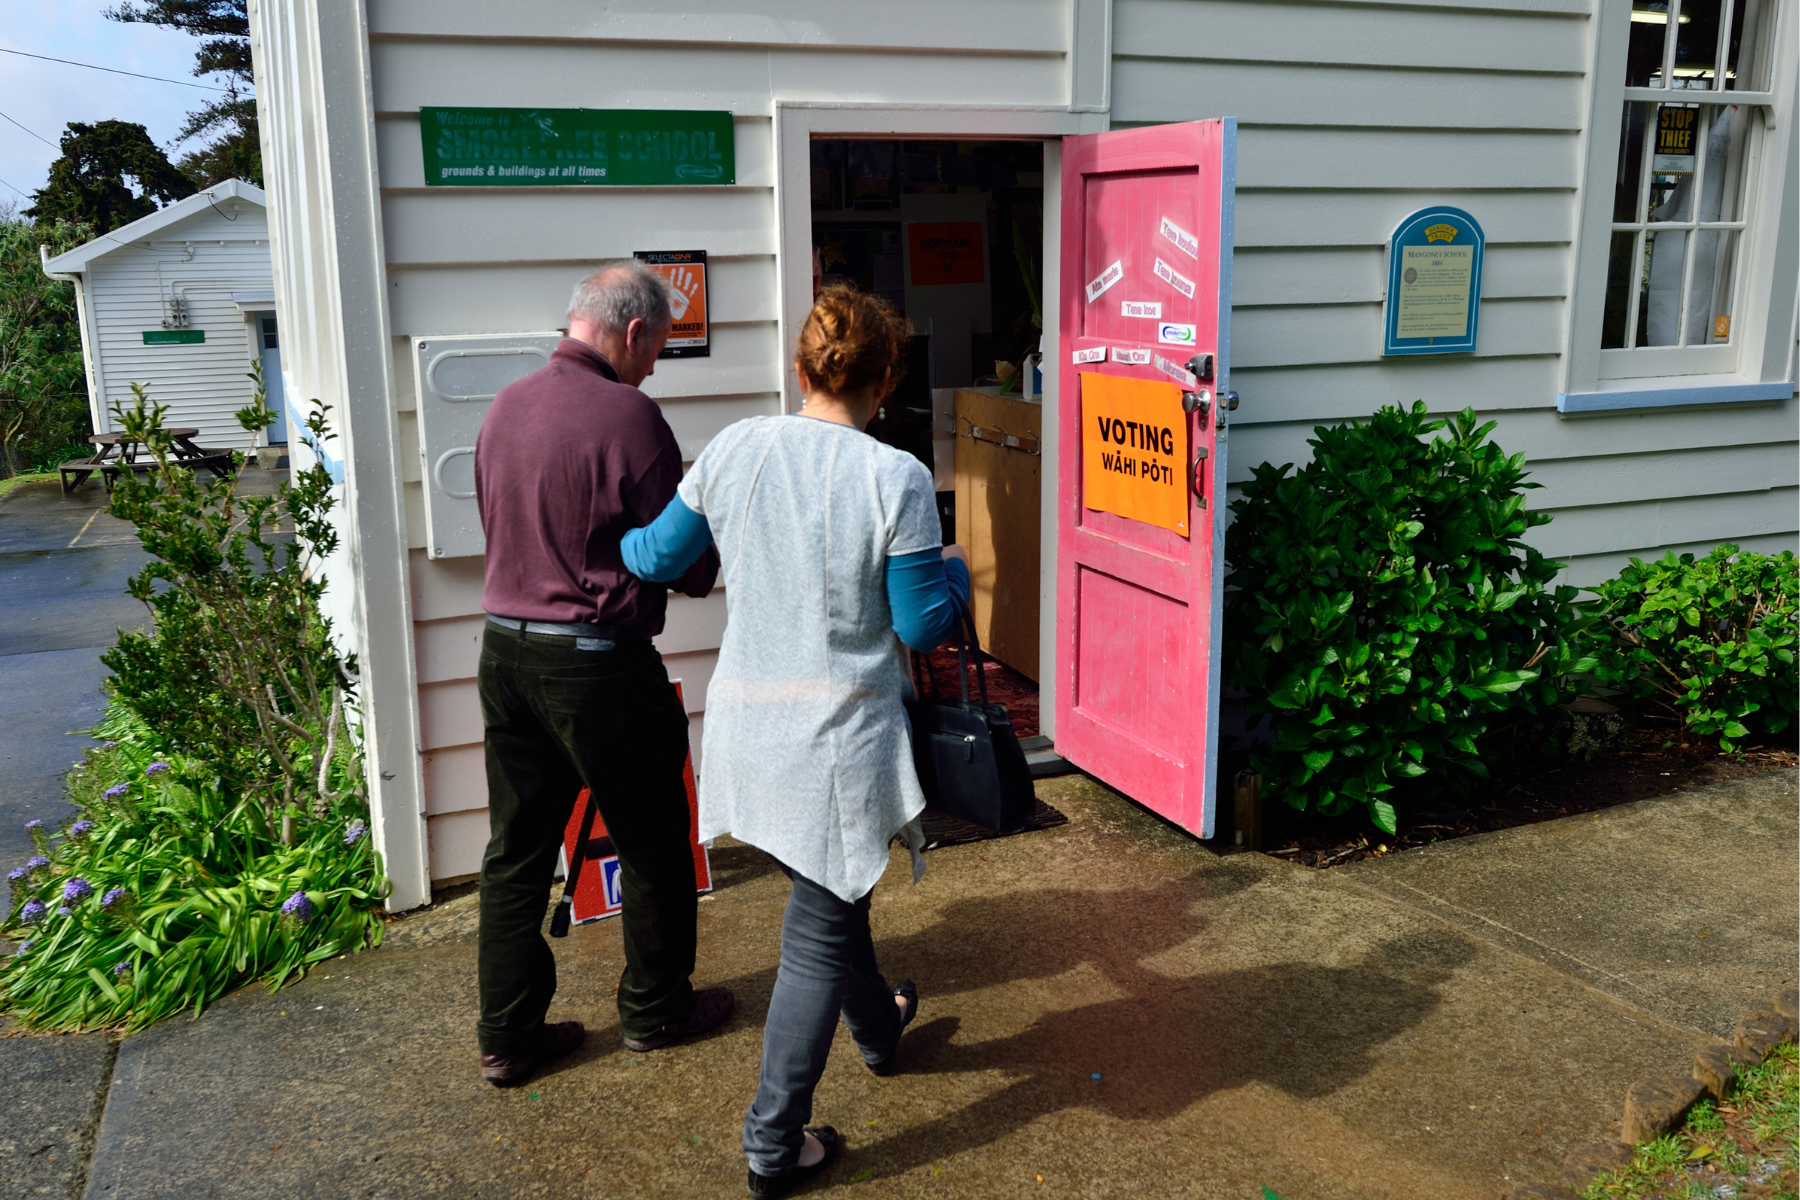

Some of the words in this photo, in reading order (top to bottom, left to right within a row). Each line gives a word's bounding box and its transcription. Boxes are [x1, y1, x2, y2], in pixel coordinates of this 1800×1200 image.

[436, 111, 493, 126] Welcome
[498, 112, 510, 126] to
[1661, 108, 1694, 128] STOP
[617, 130, 723, 160] SCHOOL
[1660, 130, 1691, 148] THIEF
[441, 165, 484, 178] grounds
[487, 165, 495, 176] &
[498, 165, 546, 178] buildings
[549, 166, 559, 176] at
[562, 166, 575, 176] all
[578, 166, 606, 176] times
[1163, 222, 1177, 242] Tena
[1428, 224, 1455, 233] HERITAGE
[1431, 232, 1451, 240] TRAILS
[920, 238, 973, 249] NORTHLAND
[1158, 260, 1170, 281] Tena
[1126, 304, 1142, 315] Tena
[1143, 303, 1156, 316] koe
[672, 322, 704, 331] MARKED!
[1428, 337, 1433, 346] 9
[1078, 351, 1088, 361] Kia
[1089, 350, 1100, 360] Ora
[1132, 351, 1146, 361] Ora
[1163, 359, 1187, 382] Morena
[1098, 416, 1174, 456] VOTING
[1102, 450, 1136, 477] WĀHI
[1142, 458, 1173, 486] PŌTI
